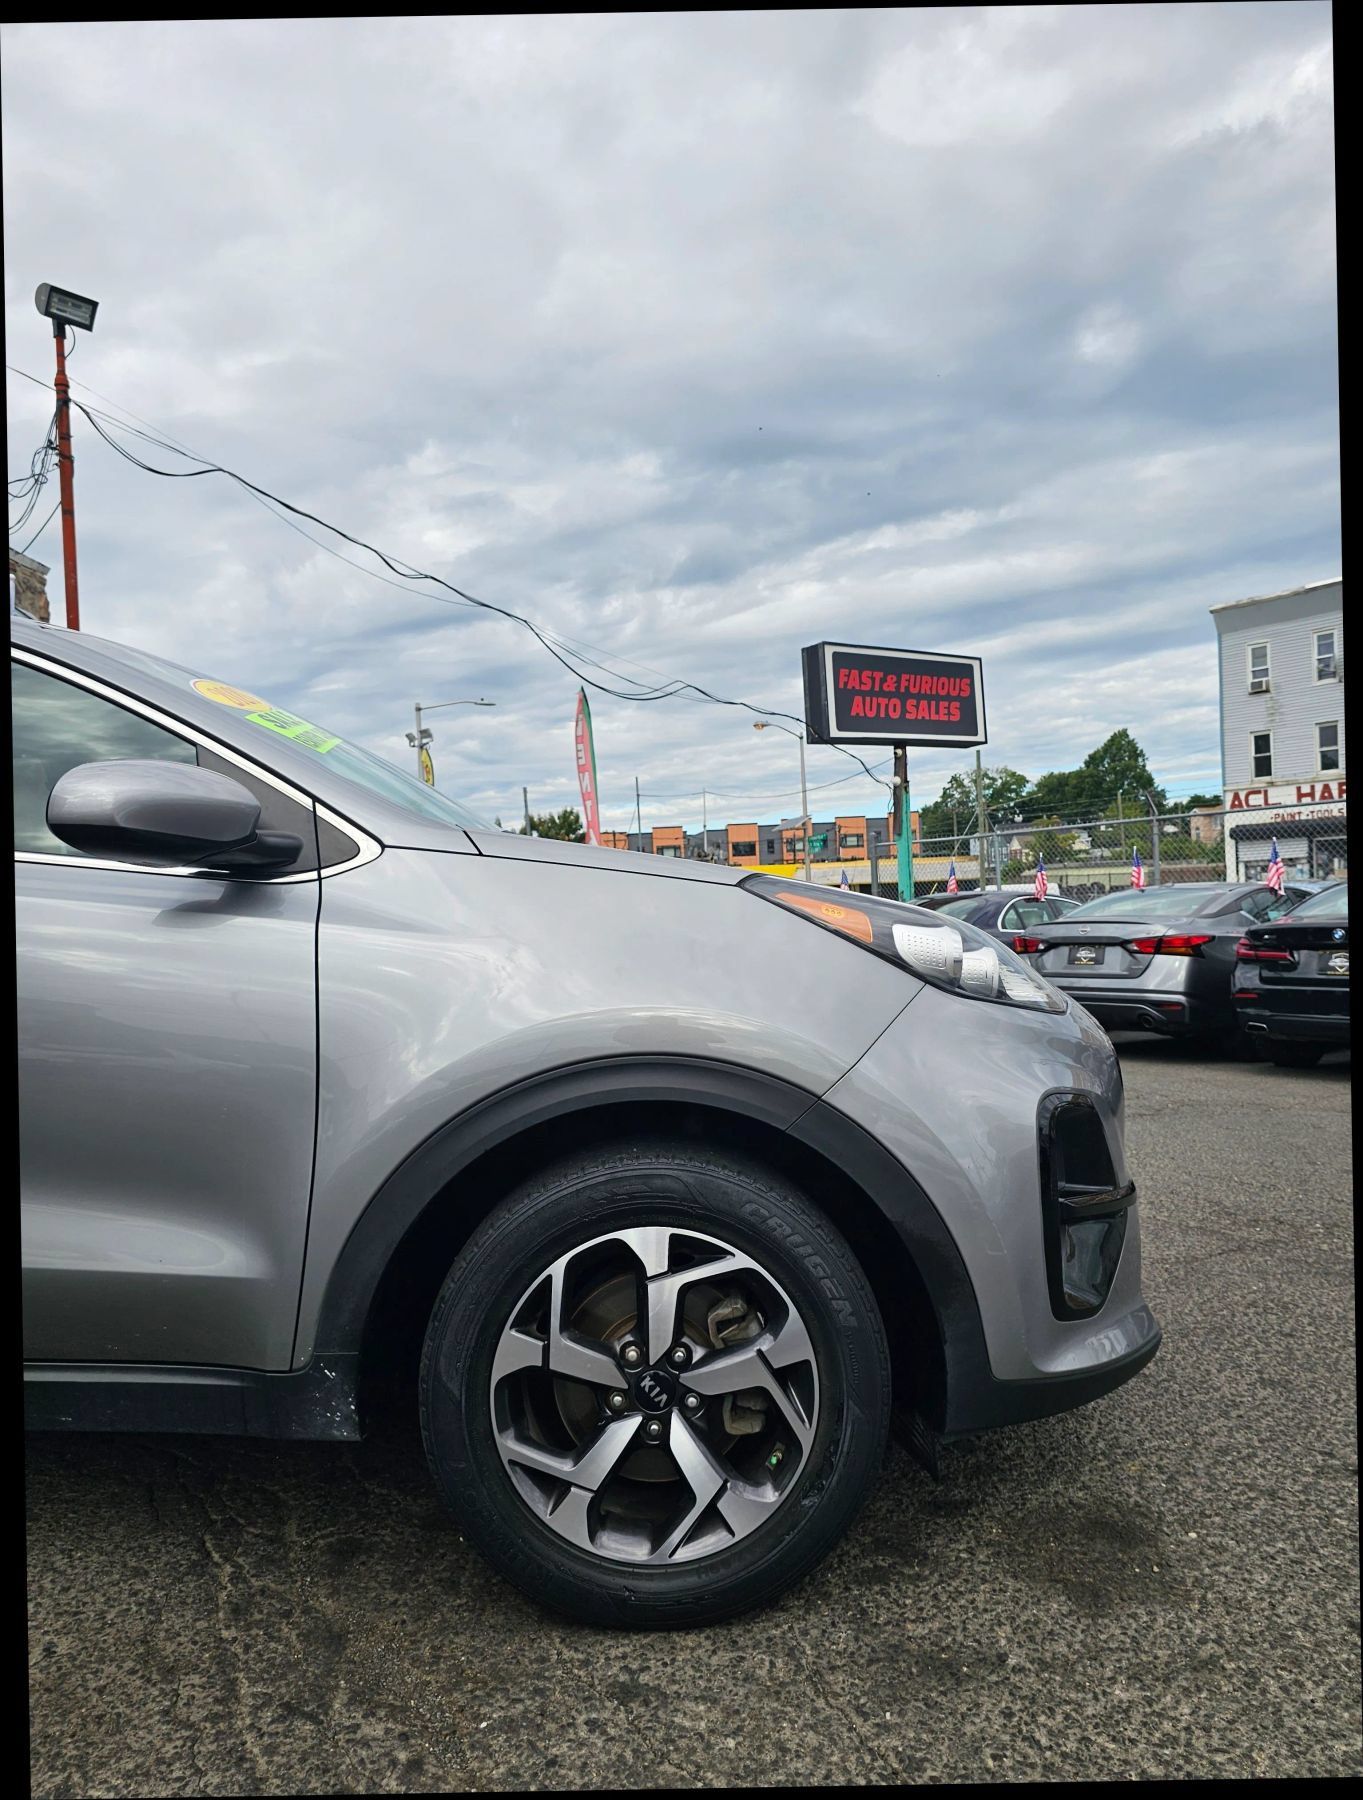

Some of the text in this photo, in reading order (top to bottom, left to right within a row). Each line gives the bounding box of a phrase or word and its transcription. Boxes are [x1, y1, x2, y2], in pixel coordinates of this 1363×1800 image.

[839, 669, 971, 697] FAST & FURIOUS
[851, 696, 961, 722] AUTO SALES
[1230, 789, 1281, 809] ACL
[1274, 807, 1345, 822] PAINT TOOLS
[640, 1375, 668, 1408] KIA
